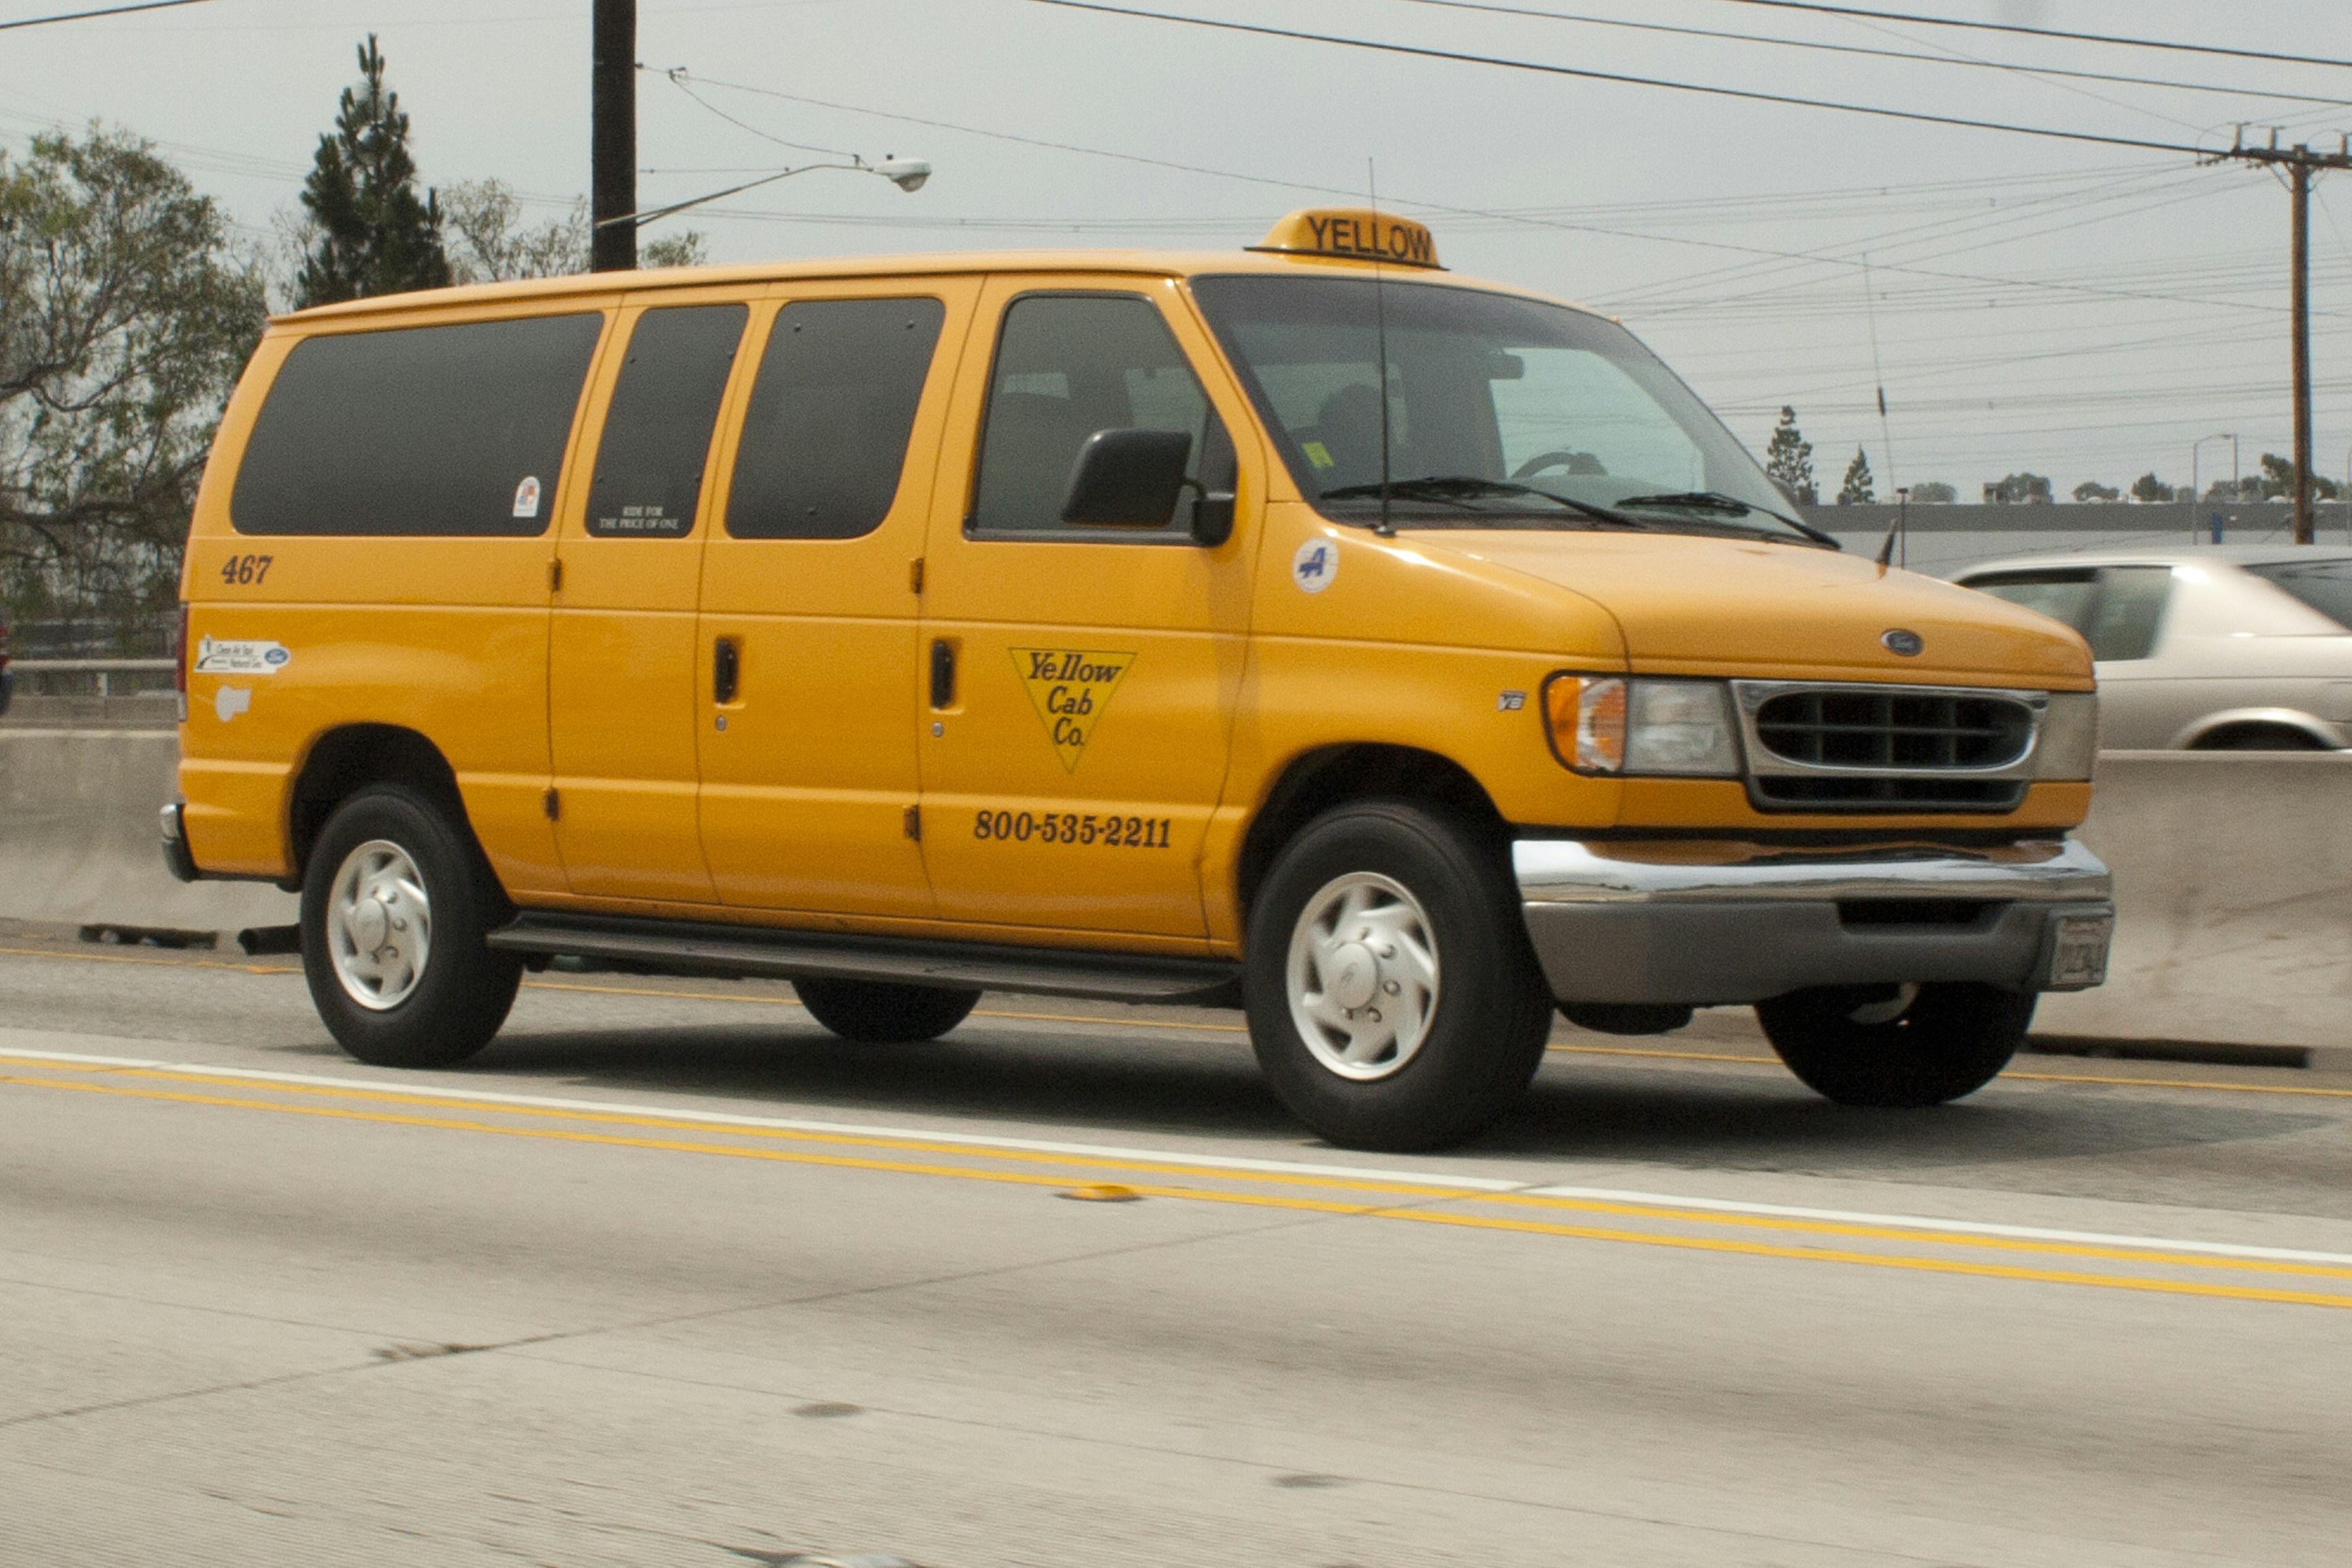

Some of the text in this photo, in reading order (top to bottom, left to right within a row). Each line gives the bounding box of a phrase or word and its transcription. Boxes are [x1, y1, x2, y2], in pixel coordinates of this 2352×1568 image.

[1307, 215, 1433, 261] YELLOW
[221, 555, 273, 585] 467
[1027, 651, 1124, 683] Yellow
[1046, 685, 1094, 715] Cab
[1053, 717, 1085, 747] Co.
[974, 810, 1171, 849] 800-535-2211
